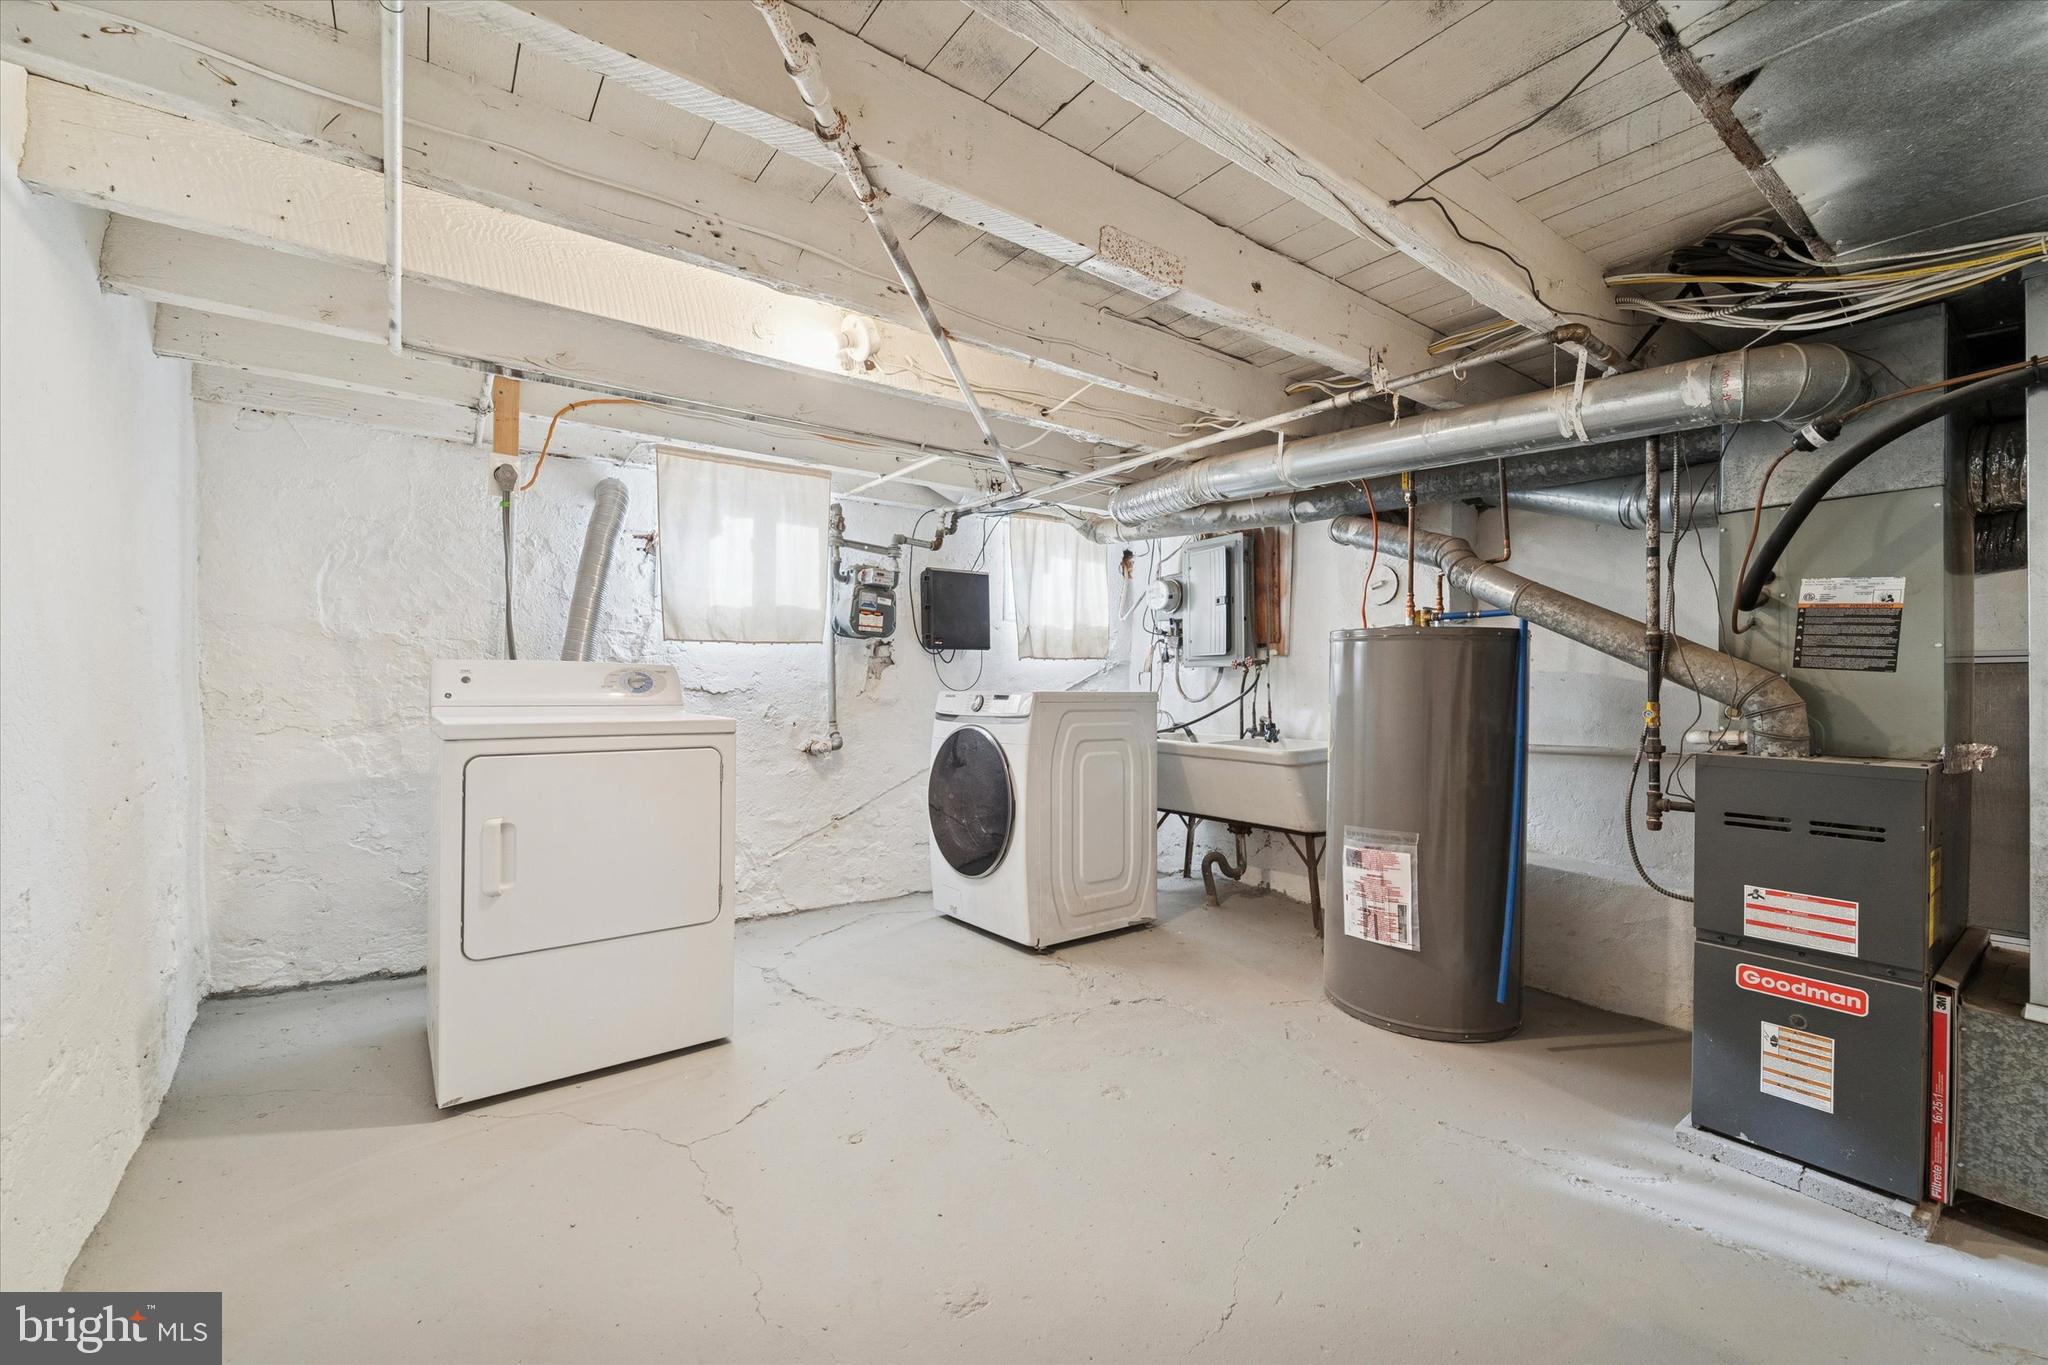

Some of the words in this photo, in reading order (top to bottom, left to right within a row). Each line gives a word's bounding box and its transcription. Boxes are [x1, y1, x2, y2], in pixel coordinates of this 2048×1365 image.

[1742, 970, 1862, 1010] Goodman
[1936, 995, 1947, 1011] 3M
[1930, 1164, 1943, 1200] Filtrete
